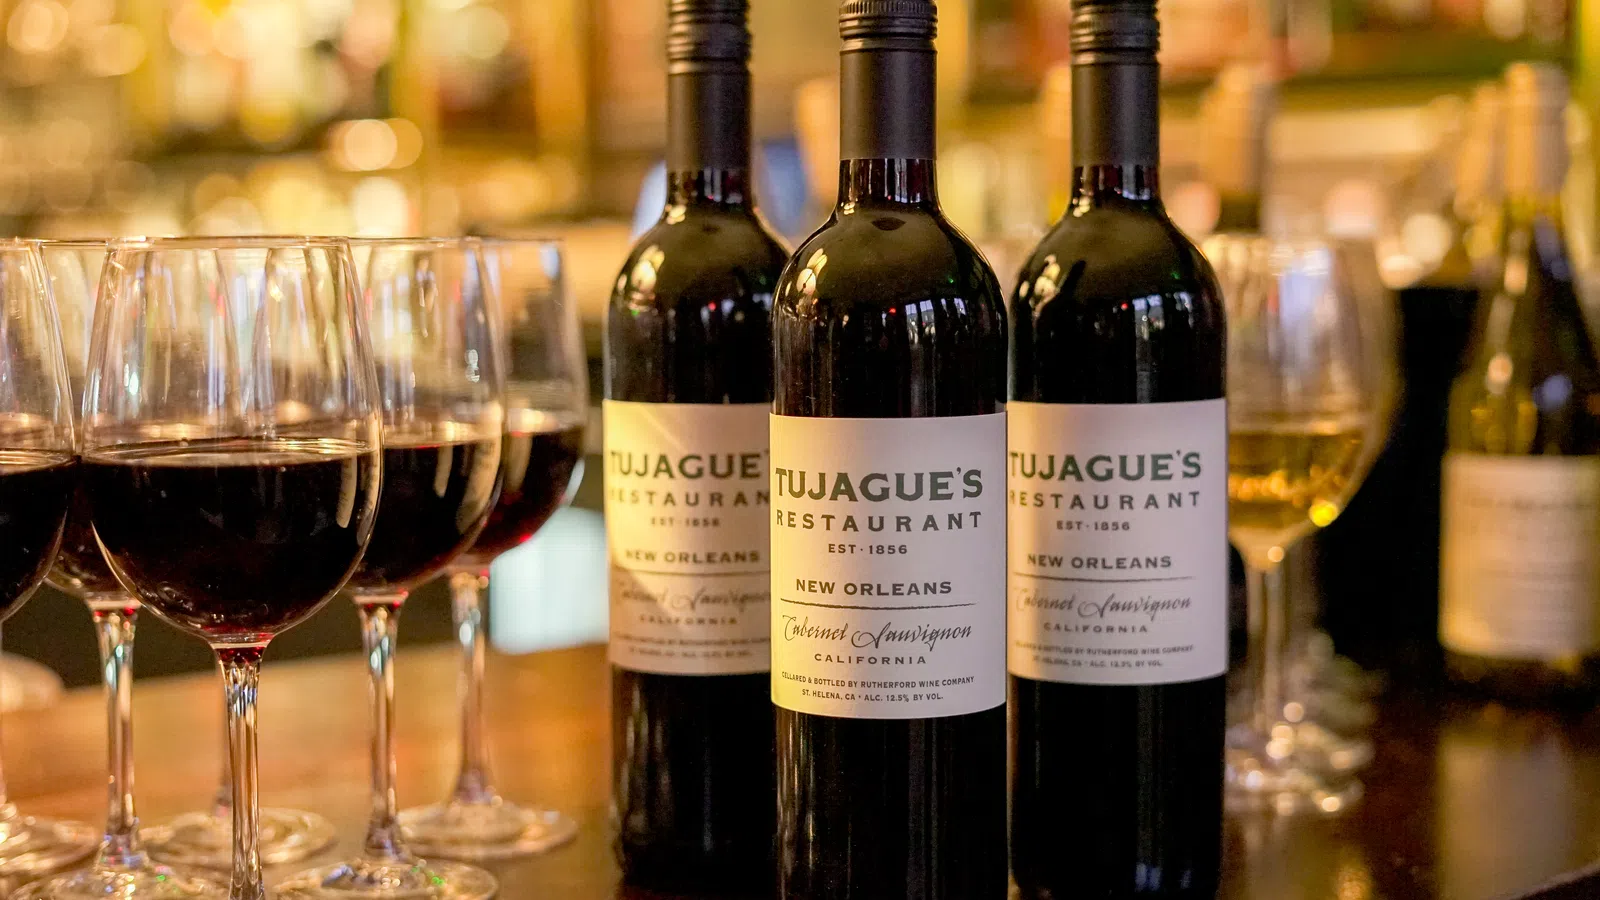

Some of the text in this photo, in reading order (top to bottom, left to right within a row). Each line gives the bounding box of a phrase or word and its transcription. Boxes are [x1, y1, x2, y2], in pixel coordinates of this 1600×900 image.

[1009, 450, 1201, 482] TUJAGUE'S
[775, 467, 983, 502] TUJAGUE'S
[1009, 490, 1200, 510] RESTAURANT
[776, 509, 982, 532] RESTAURANT
[625, 550, 760, 564] NEW ORLEANS
[1028, 553, 1172, 570] NEW ORLEANS
[796, 578, 952, 596] NEW ORLEANS
[1077, 593, 1191, 622] Sauvignon
[782, 614, 848, 642] Cabernet
[851, 621, 972, 652] Sauvignon
[1043, 622, 1148, 634] CALIFORNIA
[814, 653, 927, 665] CALIFORNIA
[781, 671, 807, 683] CELLARED
[813, 677, 846, 687] BOTTLED
[848, 680, 858, 688] BY
[860, 681, 917, 689] RUTHERFORD
[918, 679, 940, 688] WINE
[941, 676, 975, 687] COMPANY
[801, 688, 811, 697] ST.
[844, 693, 856, 701] CA
[864, 694, 883, 702] ALC.
[886, 693, 910, 703] 12.5%
[913, 693, 924, 701] BY
[926, 693, 944, 701] VOL.
